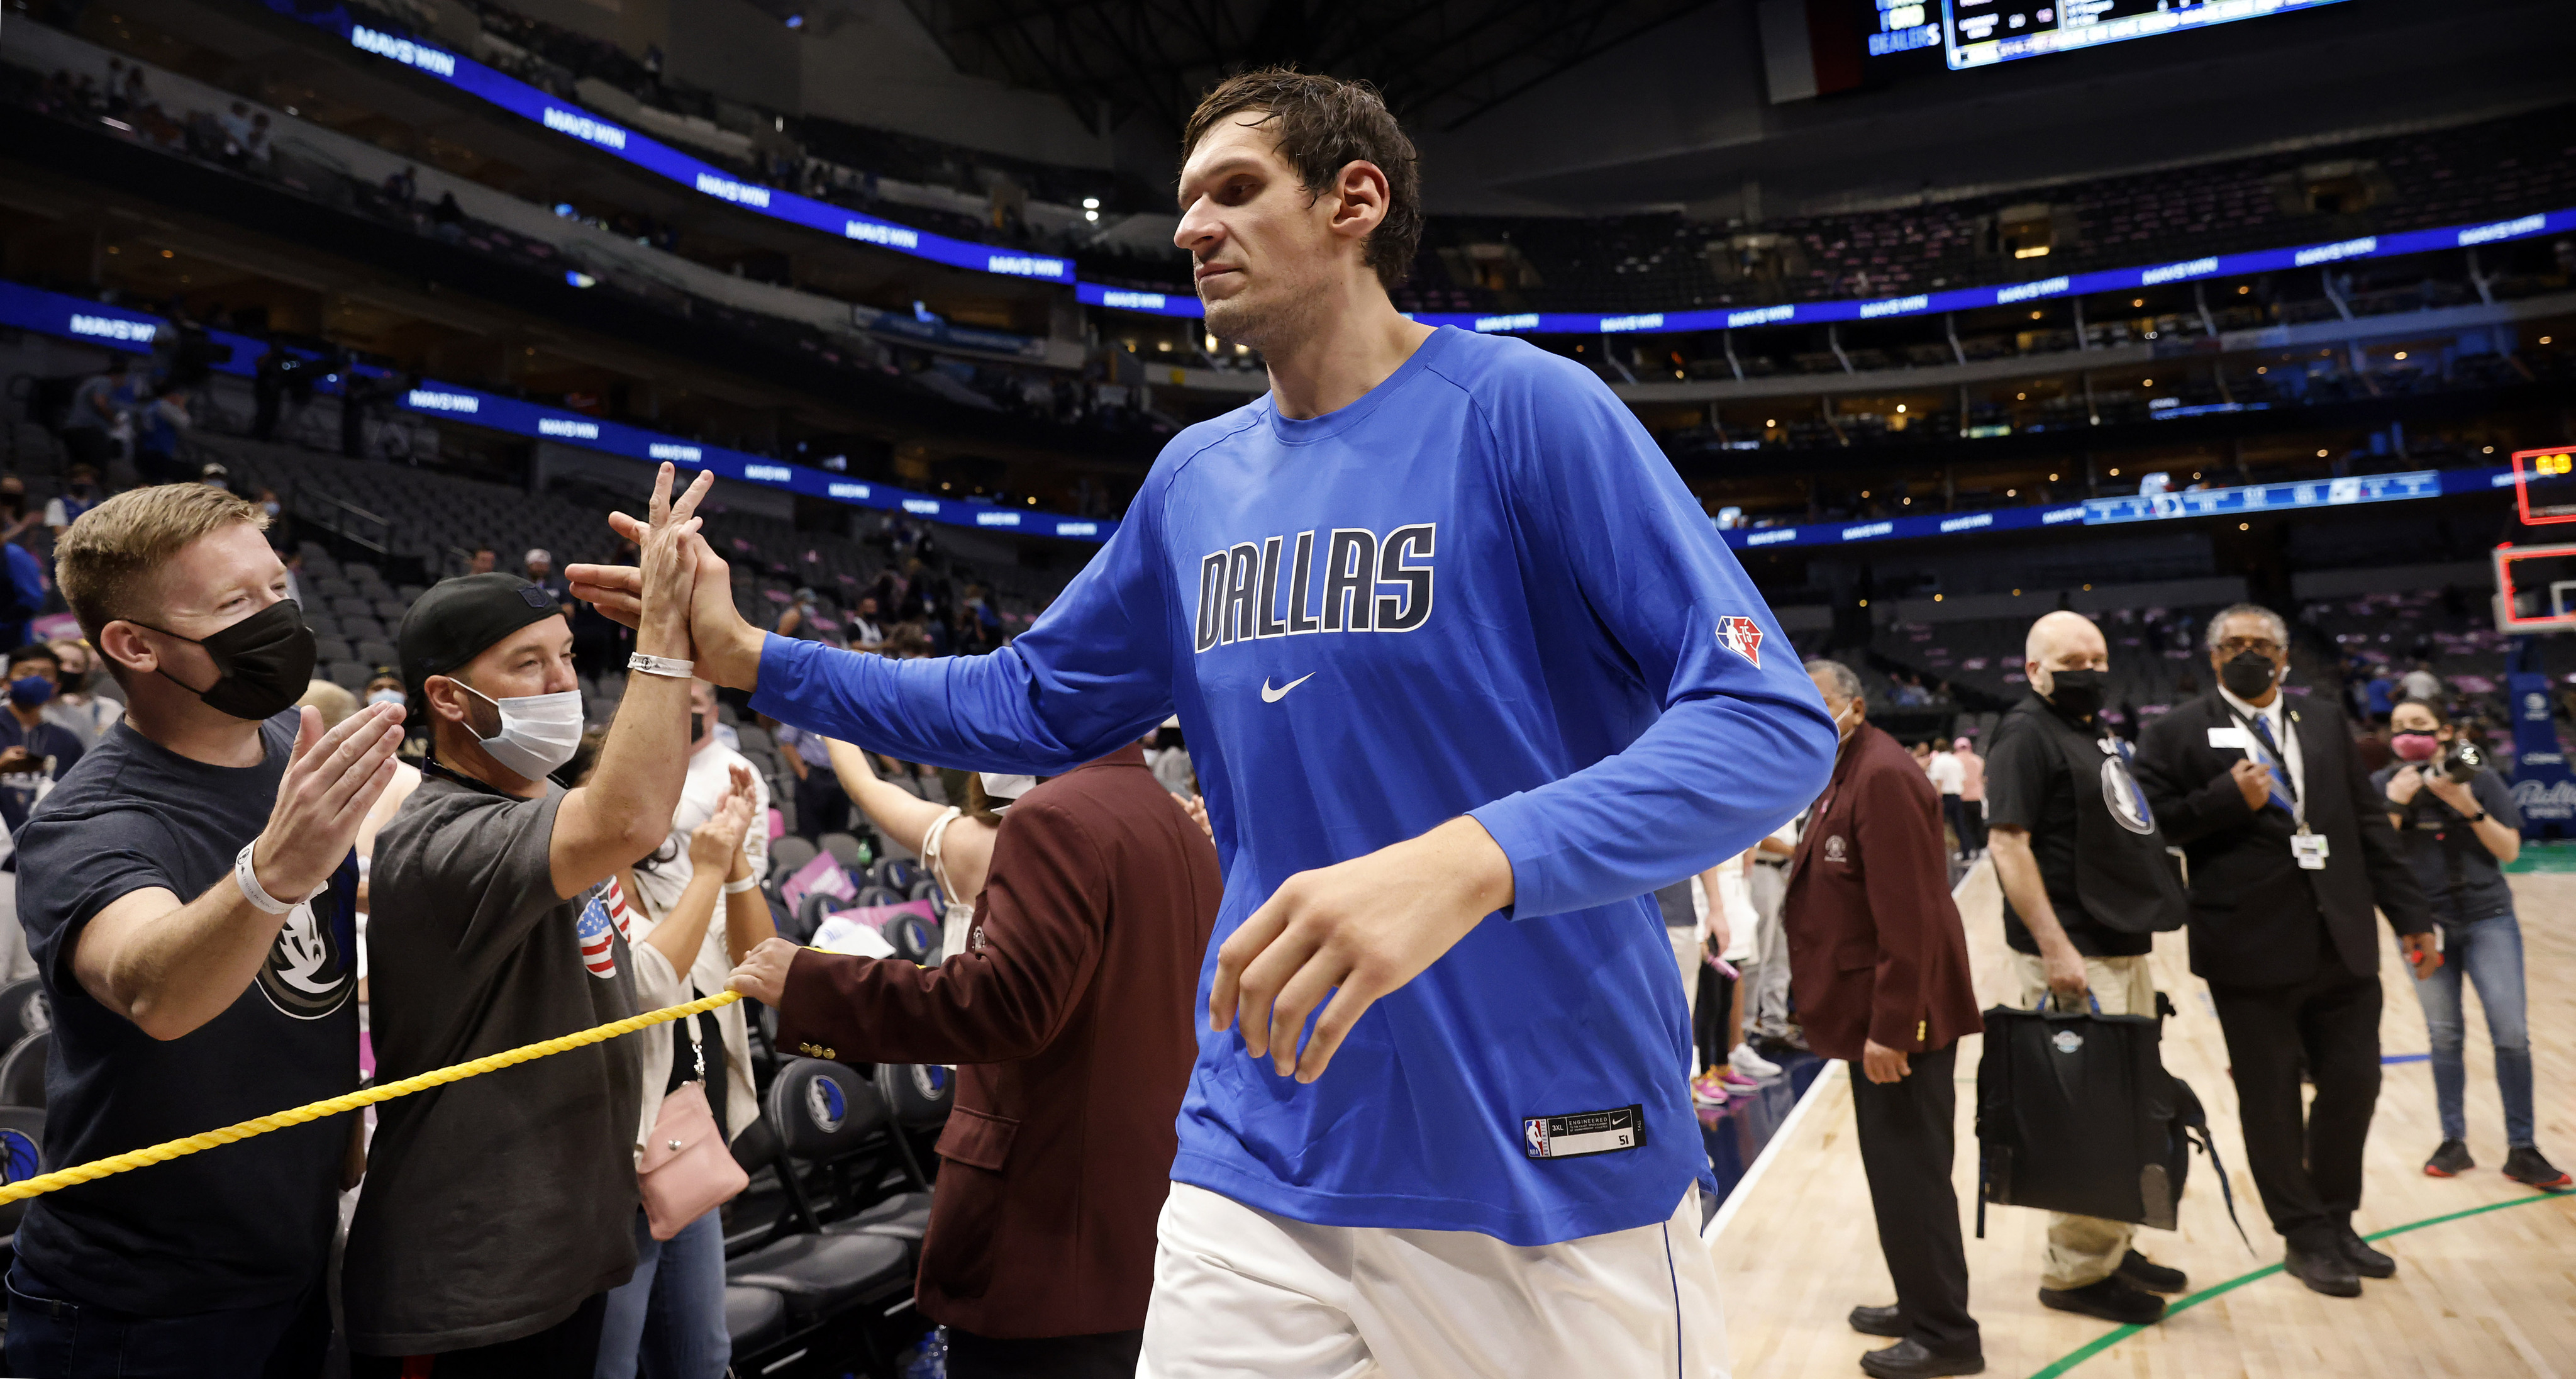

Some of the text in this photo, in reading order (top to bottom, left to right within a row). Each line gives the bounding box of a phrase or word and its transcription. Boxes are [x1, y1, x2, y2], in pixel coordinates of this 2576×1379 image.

[353, 28, 454, 75] MAVS WIN
[1868, 23, 1941, 56] DEALERS
[545, 108, 625, 149] MAVS WIN
[697, 173, 770, 208] MAVS WIN
[72, 316, 131, 339] MAVS
[1194, 522, 1436, 654] DALLAS
[1739, 626, 1753, 643] 75
[1568, 1117, 1607, 1126] ENGINEERED
[1619, 1134, 1629, 1146] 51
